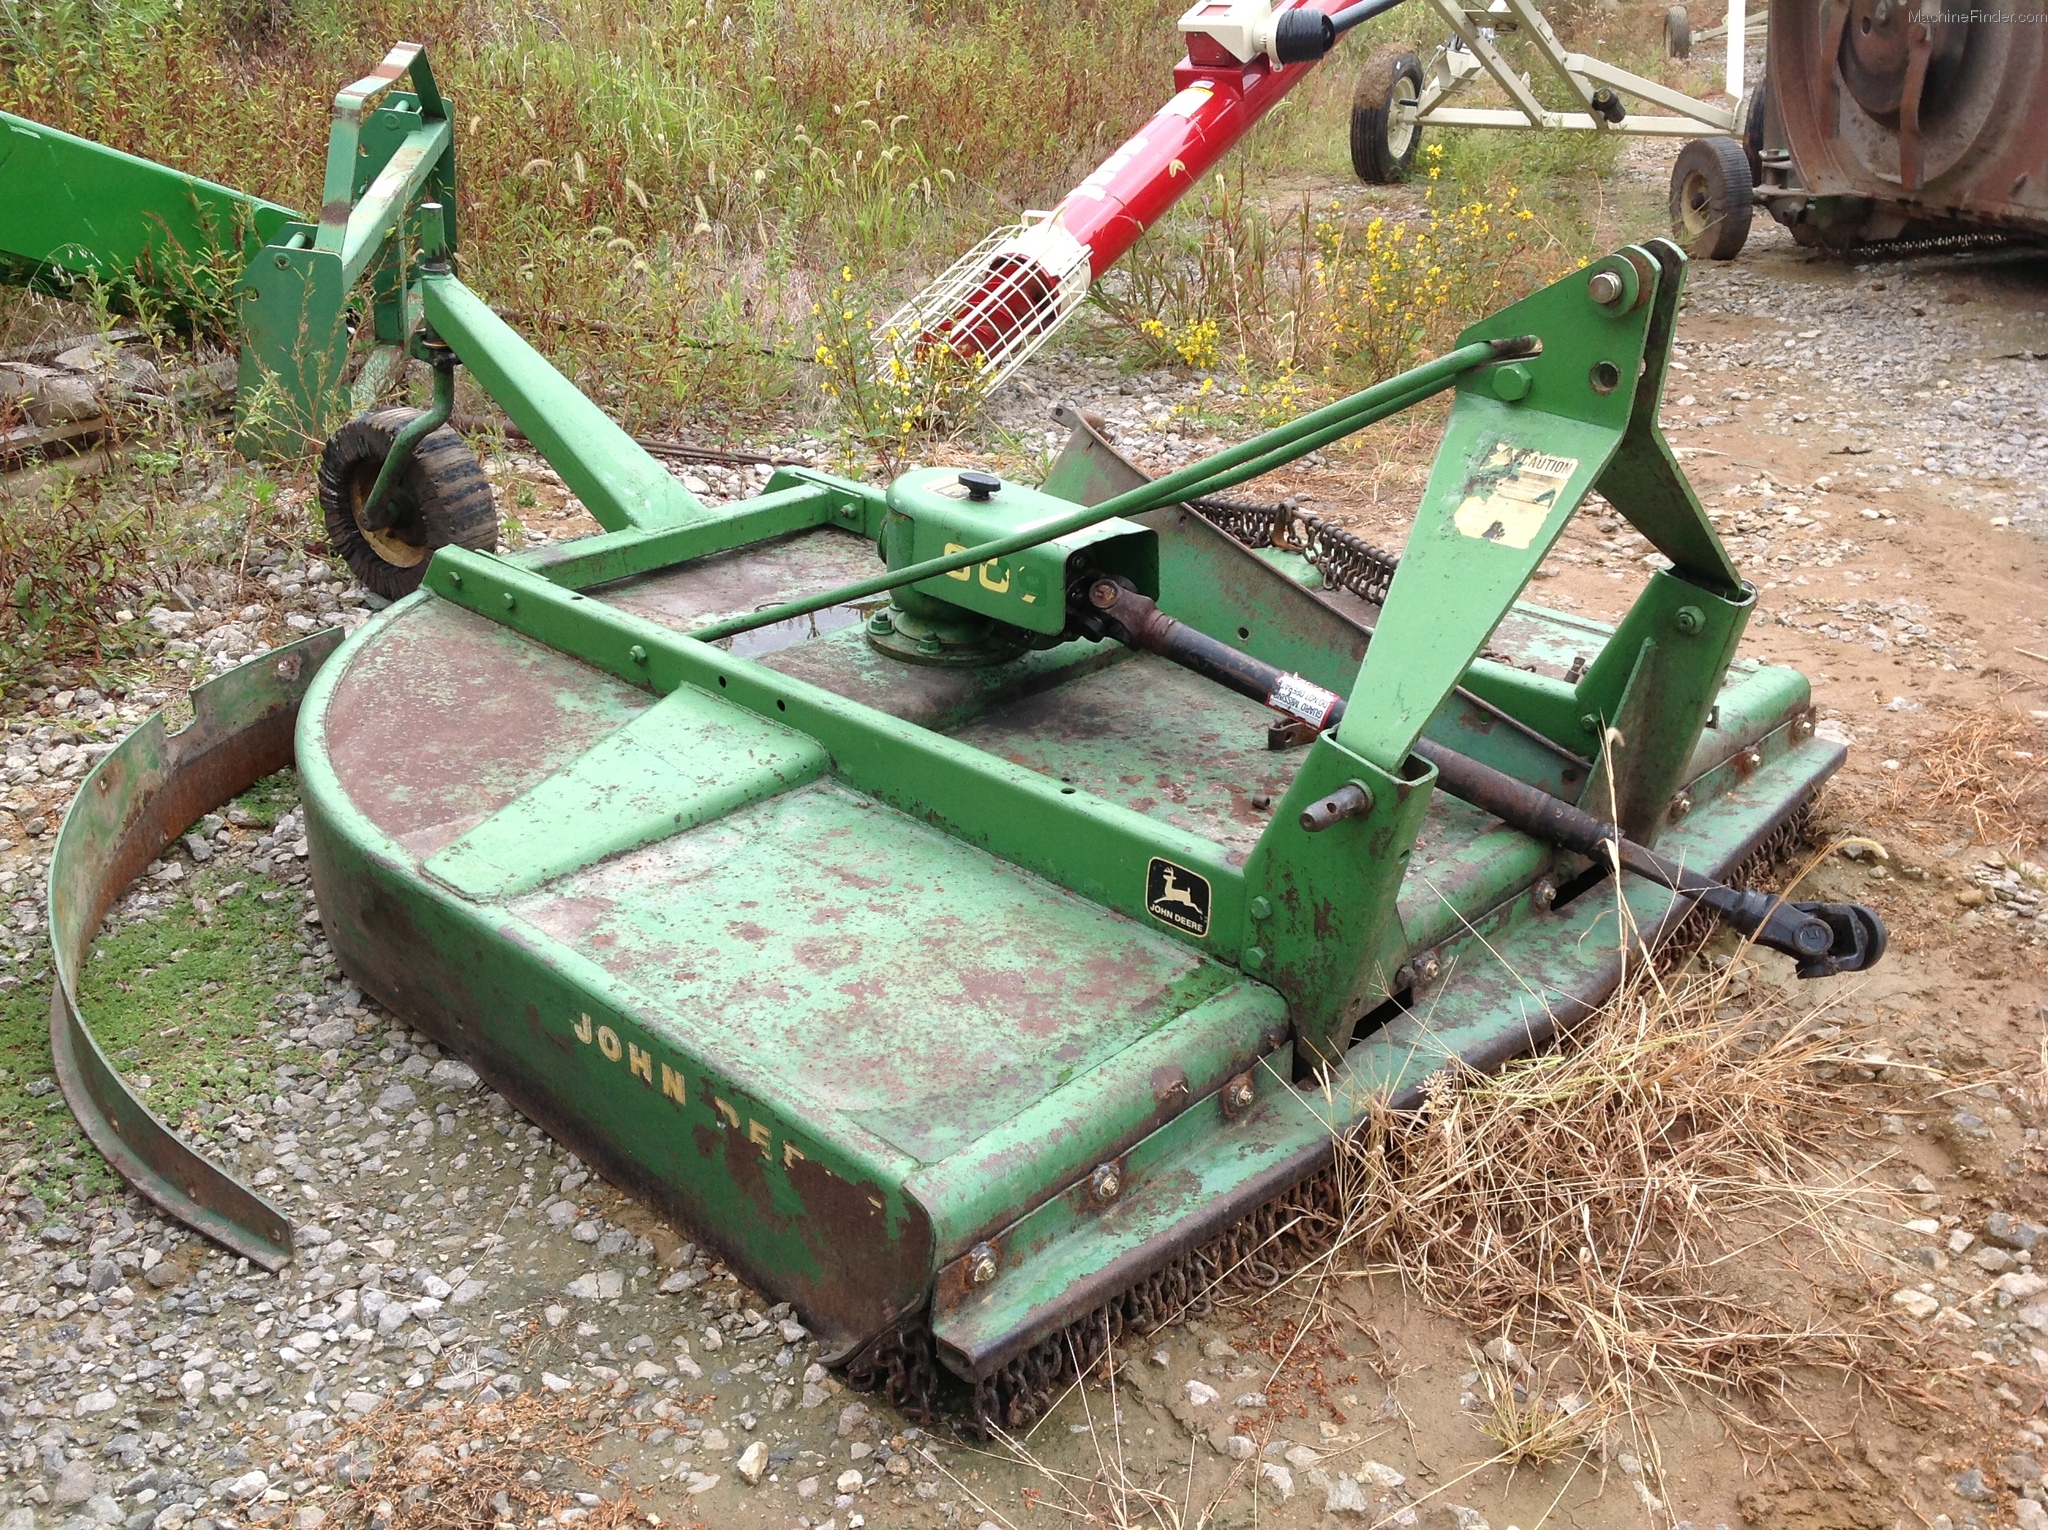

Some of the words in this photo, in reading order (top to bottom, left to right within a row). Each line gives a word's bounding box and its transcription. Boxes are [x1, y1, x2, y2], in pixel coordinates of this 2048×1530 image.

[1521, 454, 1573, 474] CAUTION
[1300, 702, 1324, 719] GUARD
[1150, 904, 1173, 919] JOHN
[1174, 913, 1204, 932] DEERE
[571, 1012, 686, 1106] JOHN
